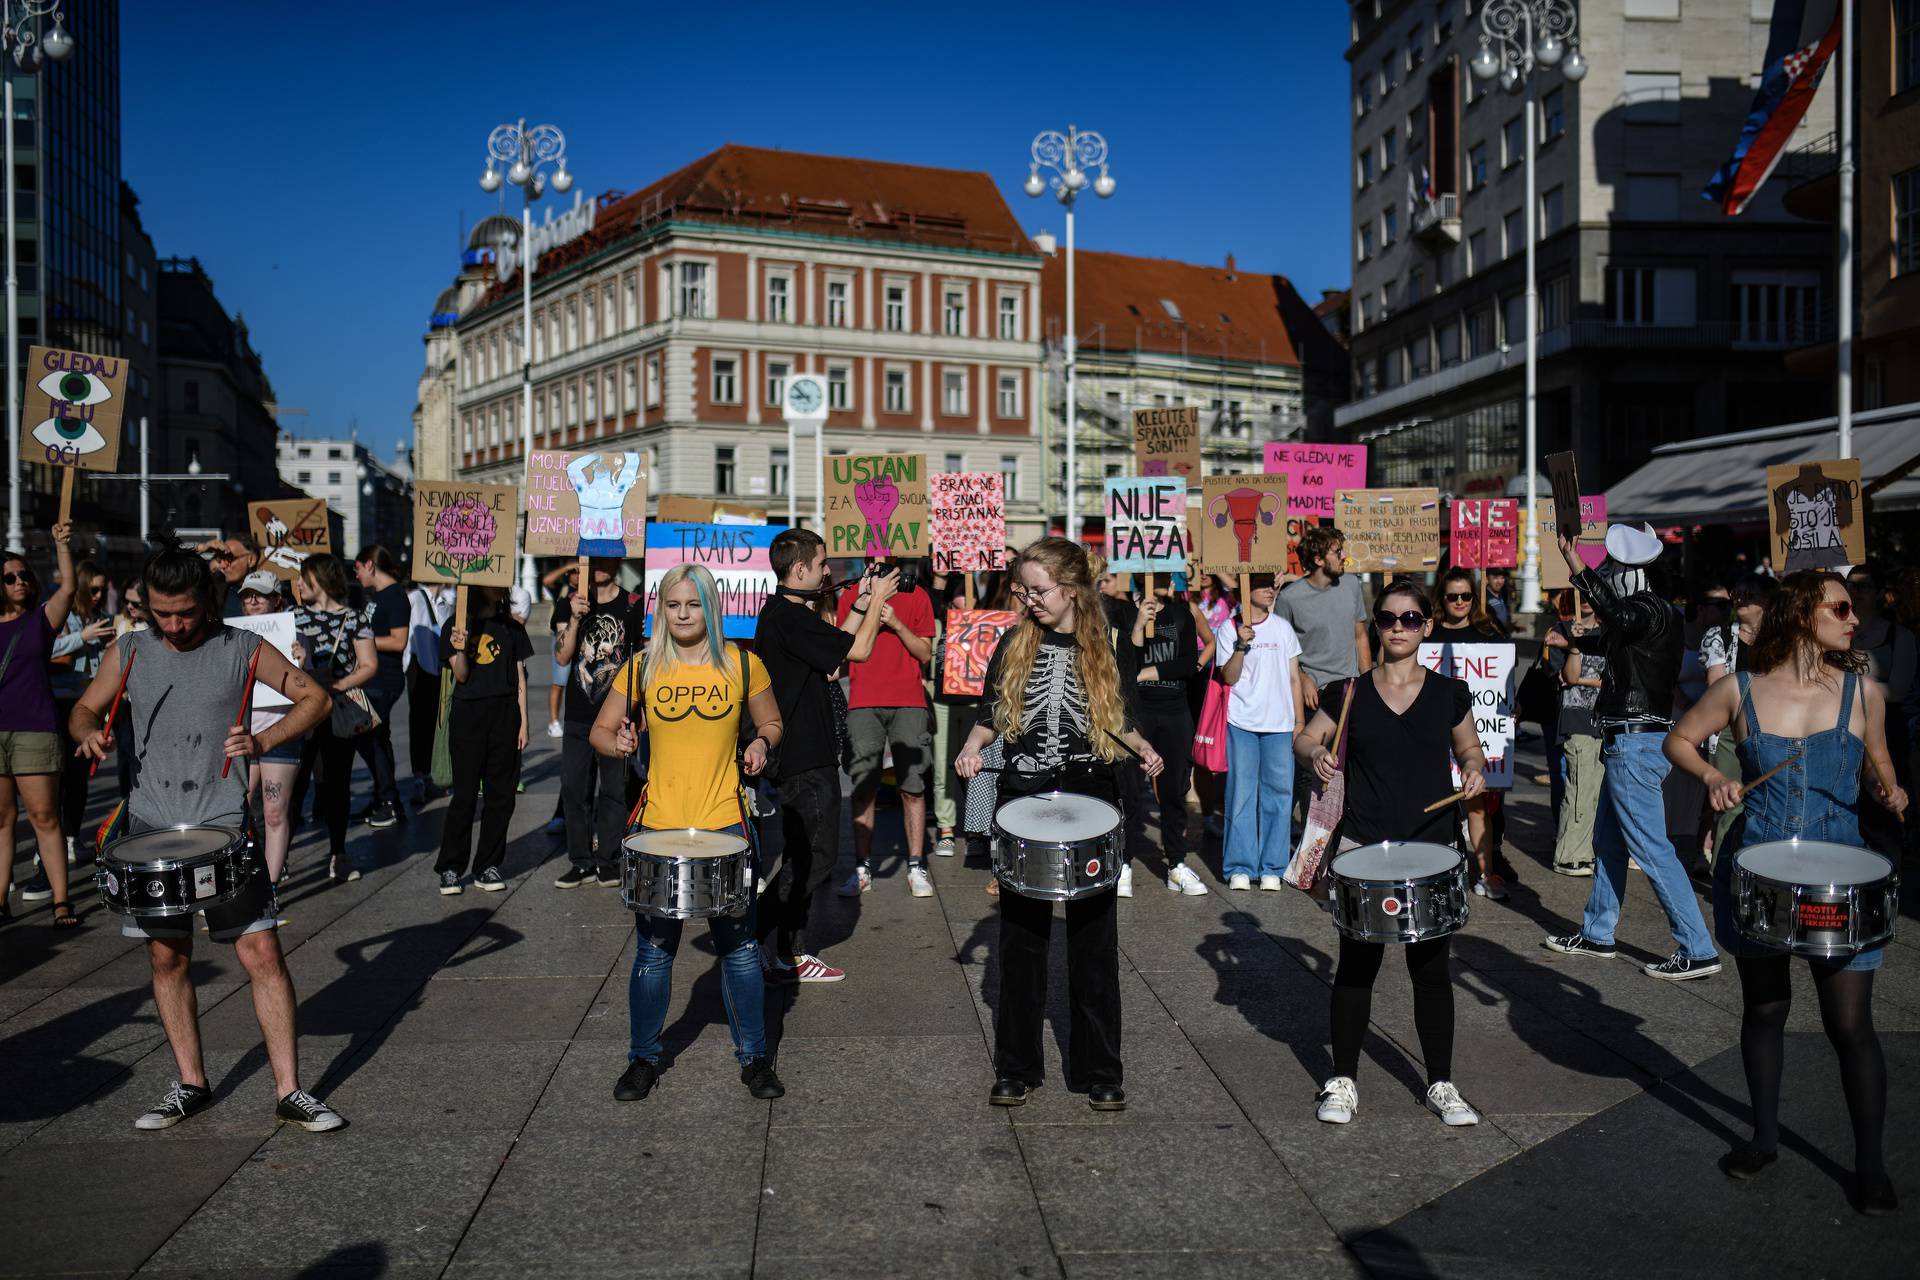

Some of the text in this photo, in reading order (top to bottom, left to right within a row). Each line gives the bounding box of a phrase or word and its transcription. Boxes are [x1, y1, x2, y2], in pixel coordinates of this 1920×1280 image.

[43, 351, 118, 379] GLEDAJ
[49, 400, 95, 422] ME U
[1190, 407, 1199, 423] U
[45, 441, 87, 467] OČI.
[1146, 439, 1188, 454] SOBI!!!
[531, 454, 570, 471] MOJE
[833, 456, 917, 484] USTANI
[1274, 452, 1355, 468] NE GLEDAJ ME
[940, 478, 995, 492] BRAK NE
[1203, 477, 1232, 486] PUSTITE
[1235, 476, 1250, 484] NAS
[1302, 475, 1324, 486] KAO
[419, 490, 505, 511] NEVINOST JE
[529, 495, 558, 511] NIJE
[829, 493, 928, 511] ZA SVOJA
[954, 492, 983, 506] ZNAČI
[1112, 486, 1176, 522] NIJE
[425, 511, 495, 531] ZASTARJELI
[936, 506, 1001, 520] PRISTANAK
[1458, 500, 1510, 528] NE
[1344, 519, 1360, 529] KOJE
[1369, 518, 1404, 528] TREBAJU
[426, 530, 489, 549] DRUŠTVENI
[673, 528, 754, 564] TRANS
[833, 522, 920, 552] PRAVA!
[936, 549, 1003, 570] NE NE
[1458, 538, 1510, 567] NE
[1204, 566, 1230, 574] PUSTITE
[645, 578, 769, 620] AOMIJA
[958, 617, 1008, 643] ŽEN
[1425, 650, 1499, 680] ŽENE
[656, 684, 728, 703] OPPAI
[1471, 688, 1513, 710] KON,
